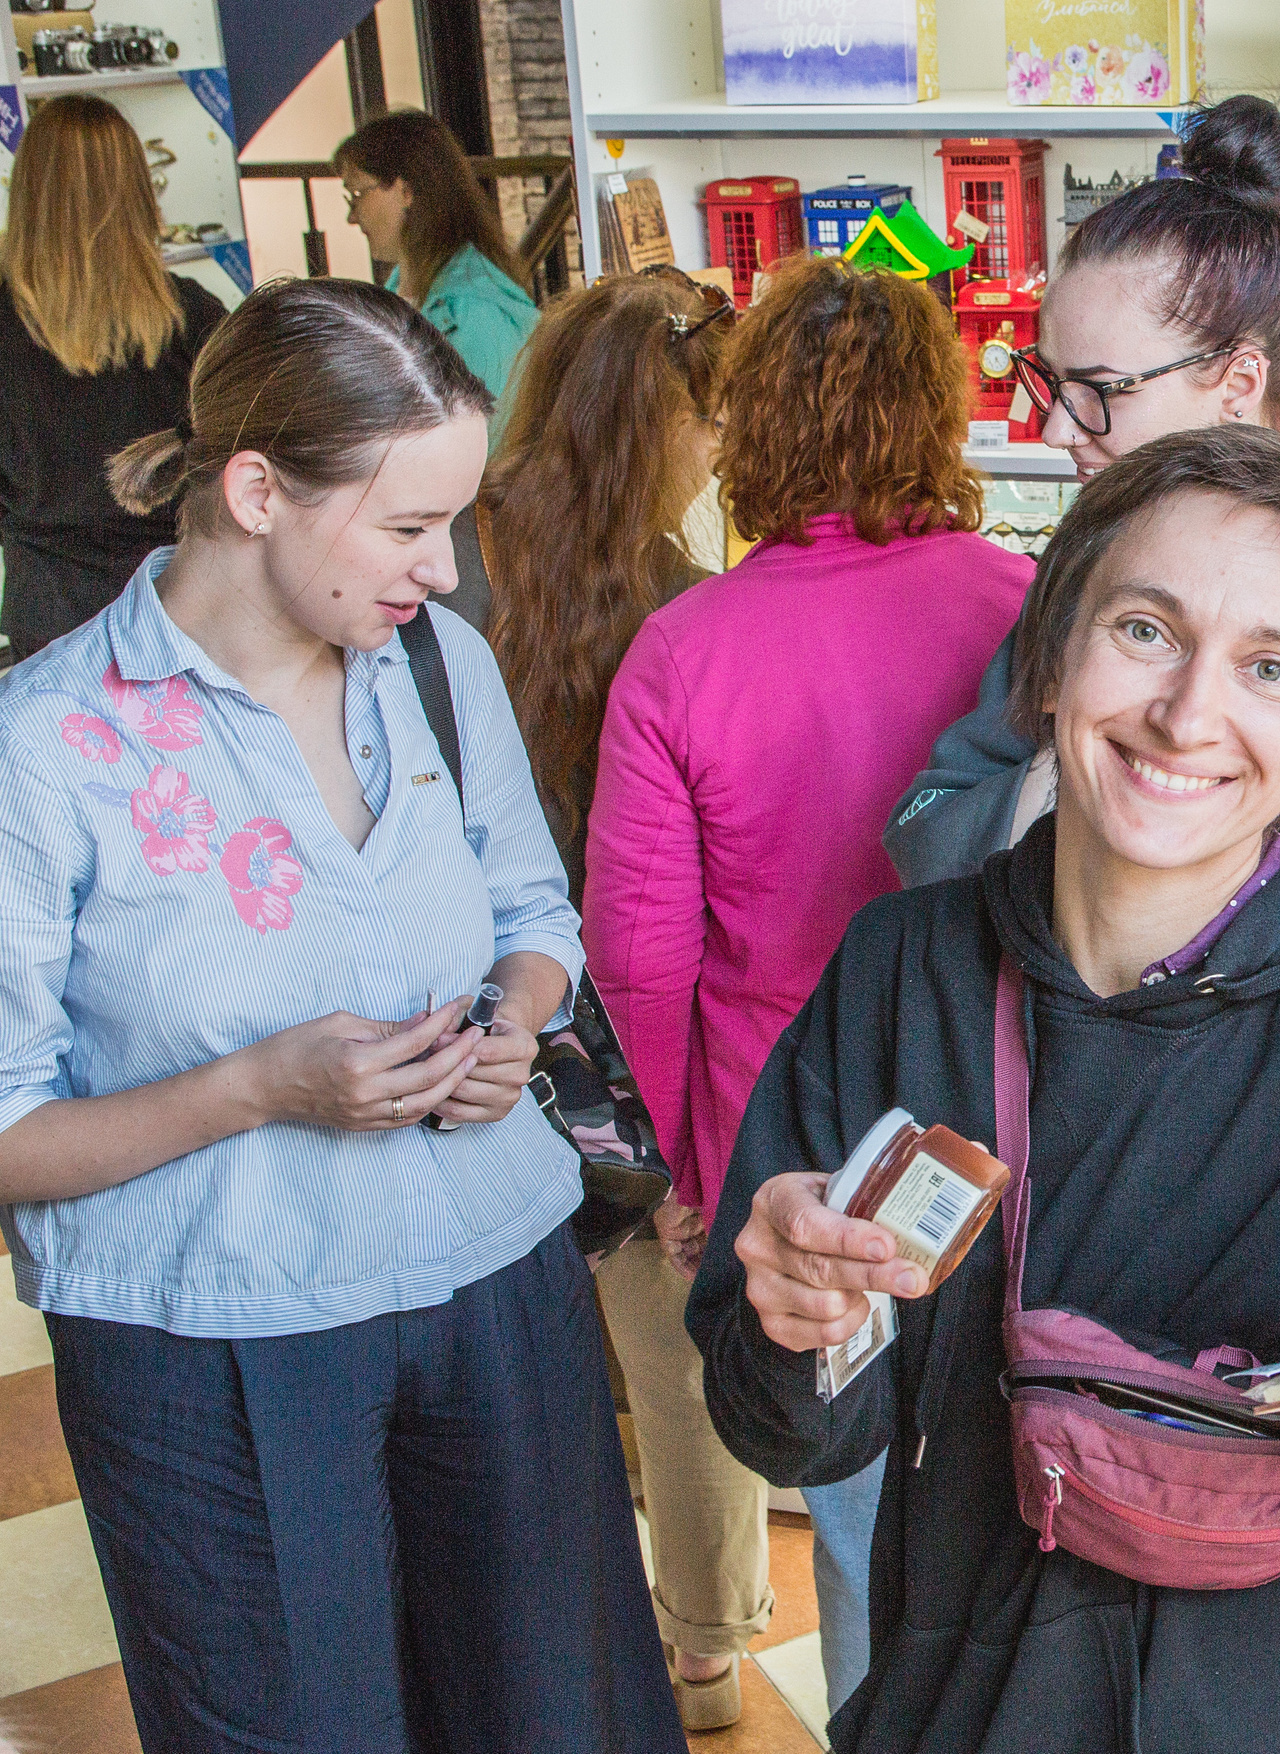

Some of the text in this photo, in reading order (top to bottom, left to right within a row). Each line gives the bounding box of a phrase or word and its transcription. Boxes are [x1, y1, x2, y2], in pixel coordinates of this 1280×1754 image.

[782, 16, 856, 59] great
[813, 199, 838, 209] POLICE
[855, 199, 872, 209] BOX
